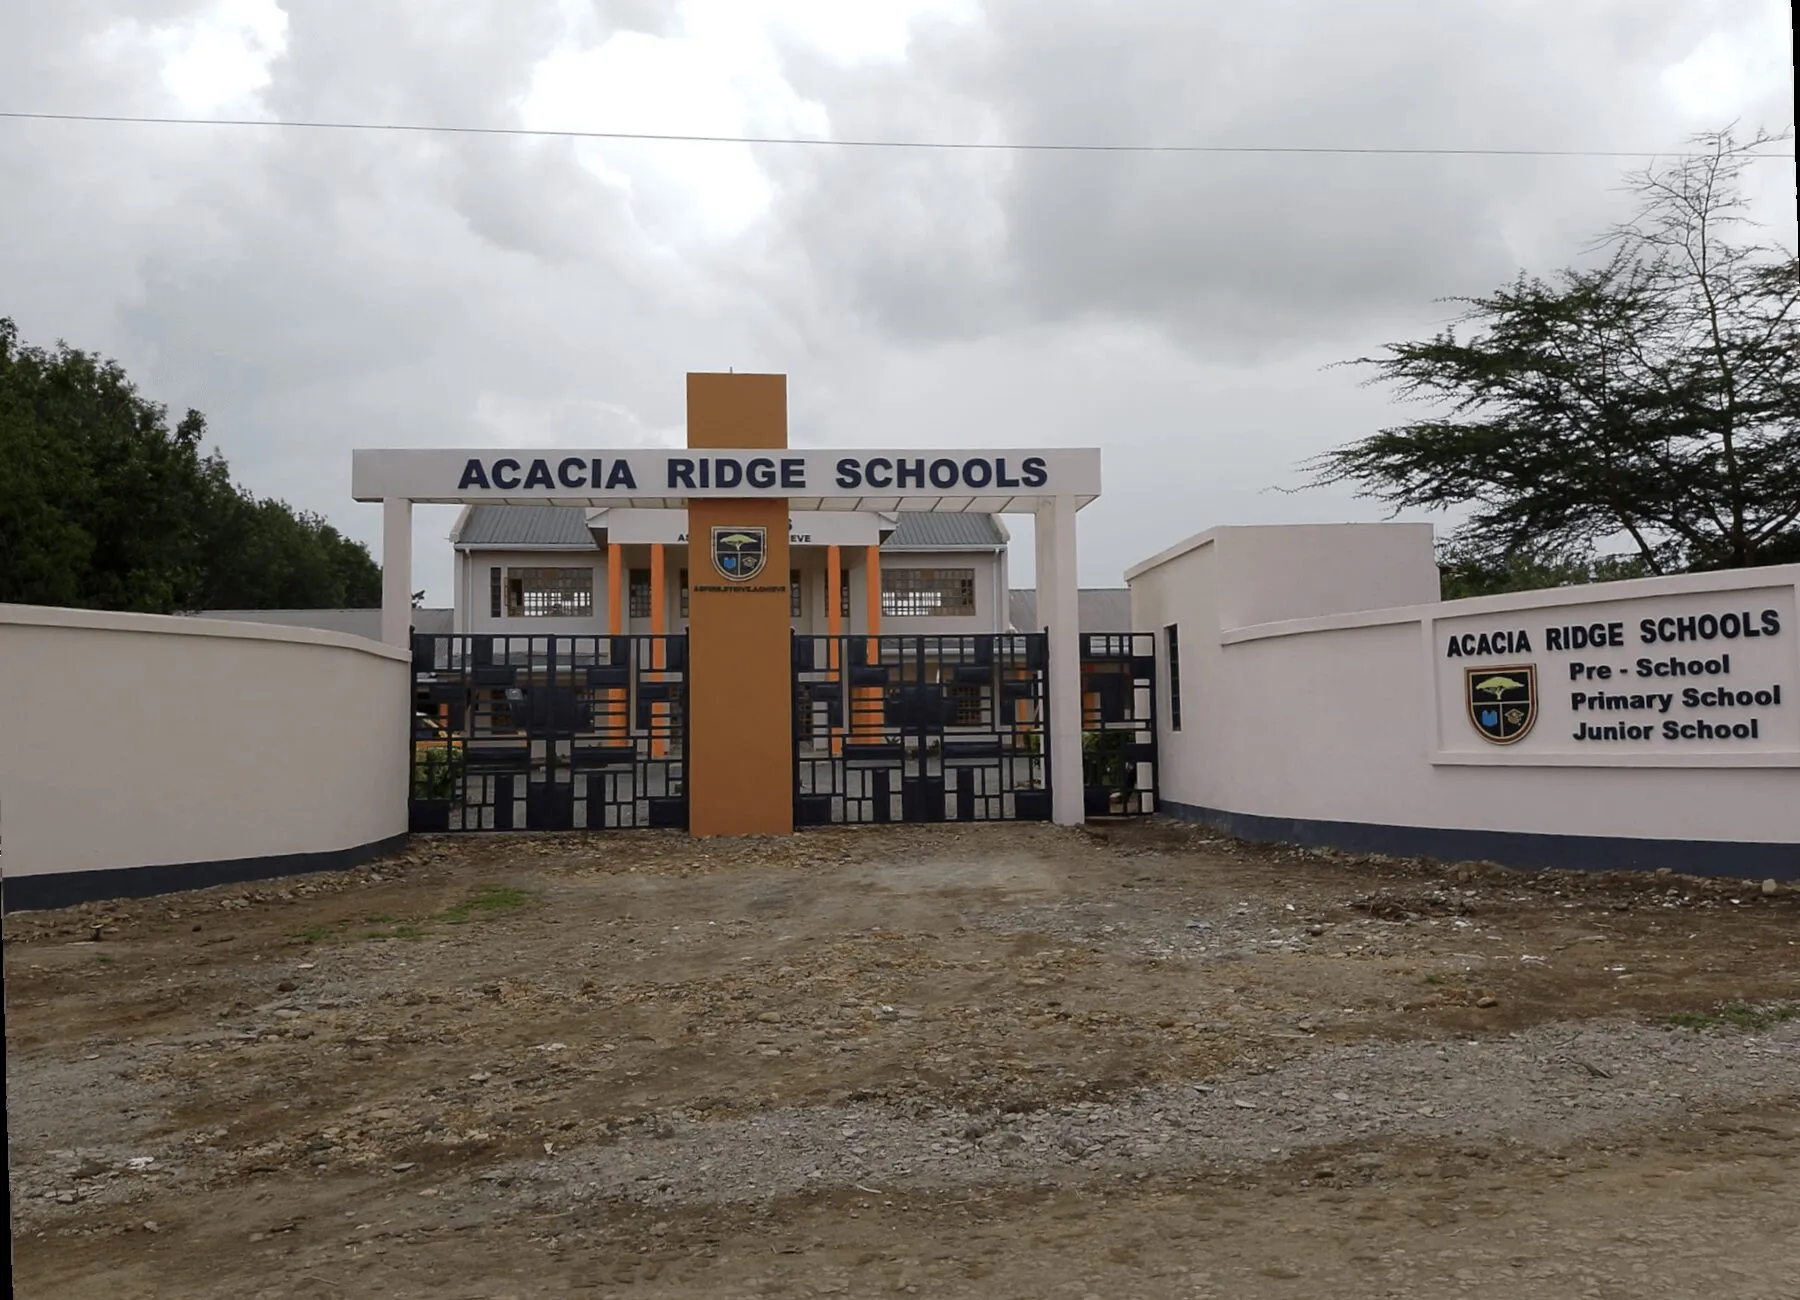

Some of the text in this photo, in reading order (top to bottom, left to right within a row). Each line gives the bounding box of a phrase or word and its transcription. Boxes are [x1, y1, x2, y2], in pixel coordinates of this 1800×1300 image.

[458, 457, 1048, 490] ACACIA RIDGE SCHOOLS
[1447, 609, 1781, 658] ACACIA RIDGE SCHOOLS
[1569, 662, 1612, 681] Pre
[1636, 654, 1730, 678] School
[1571, 685, 1781, 713] Primary School
[1572, 719, 1759, 741] Junior School
